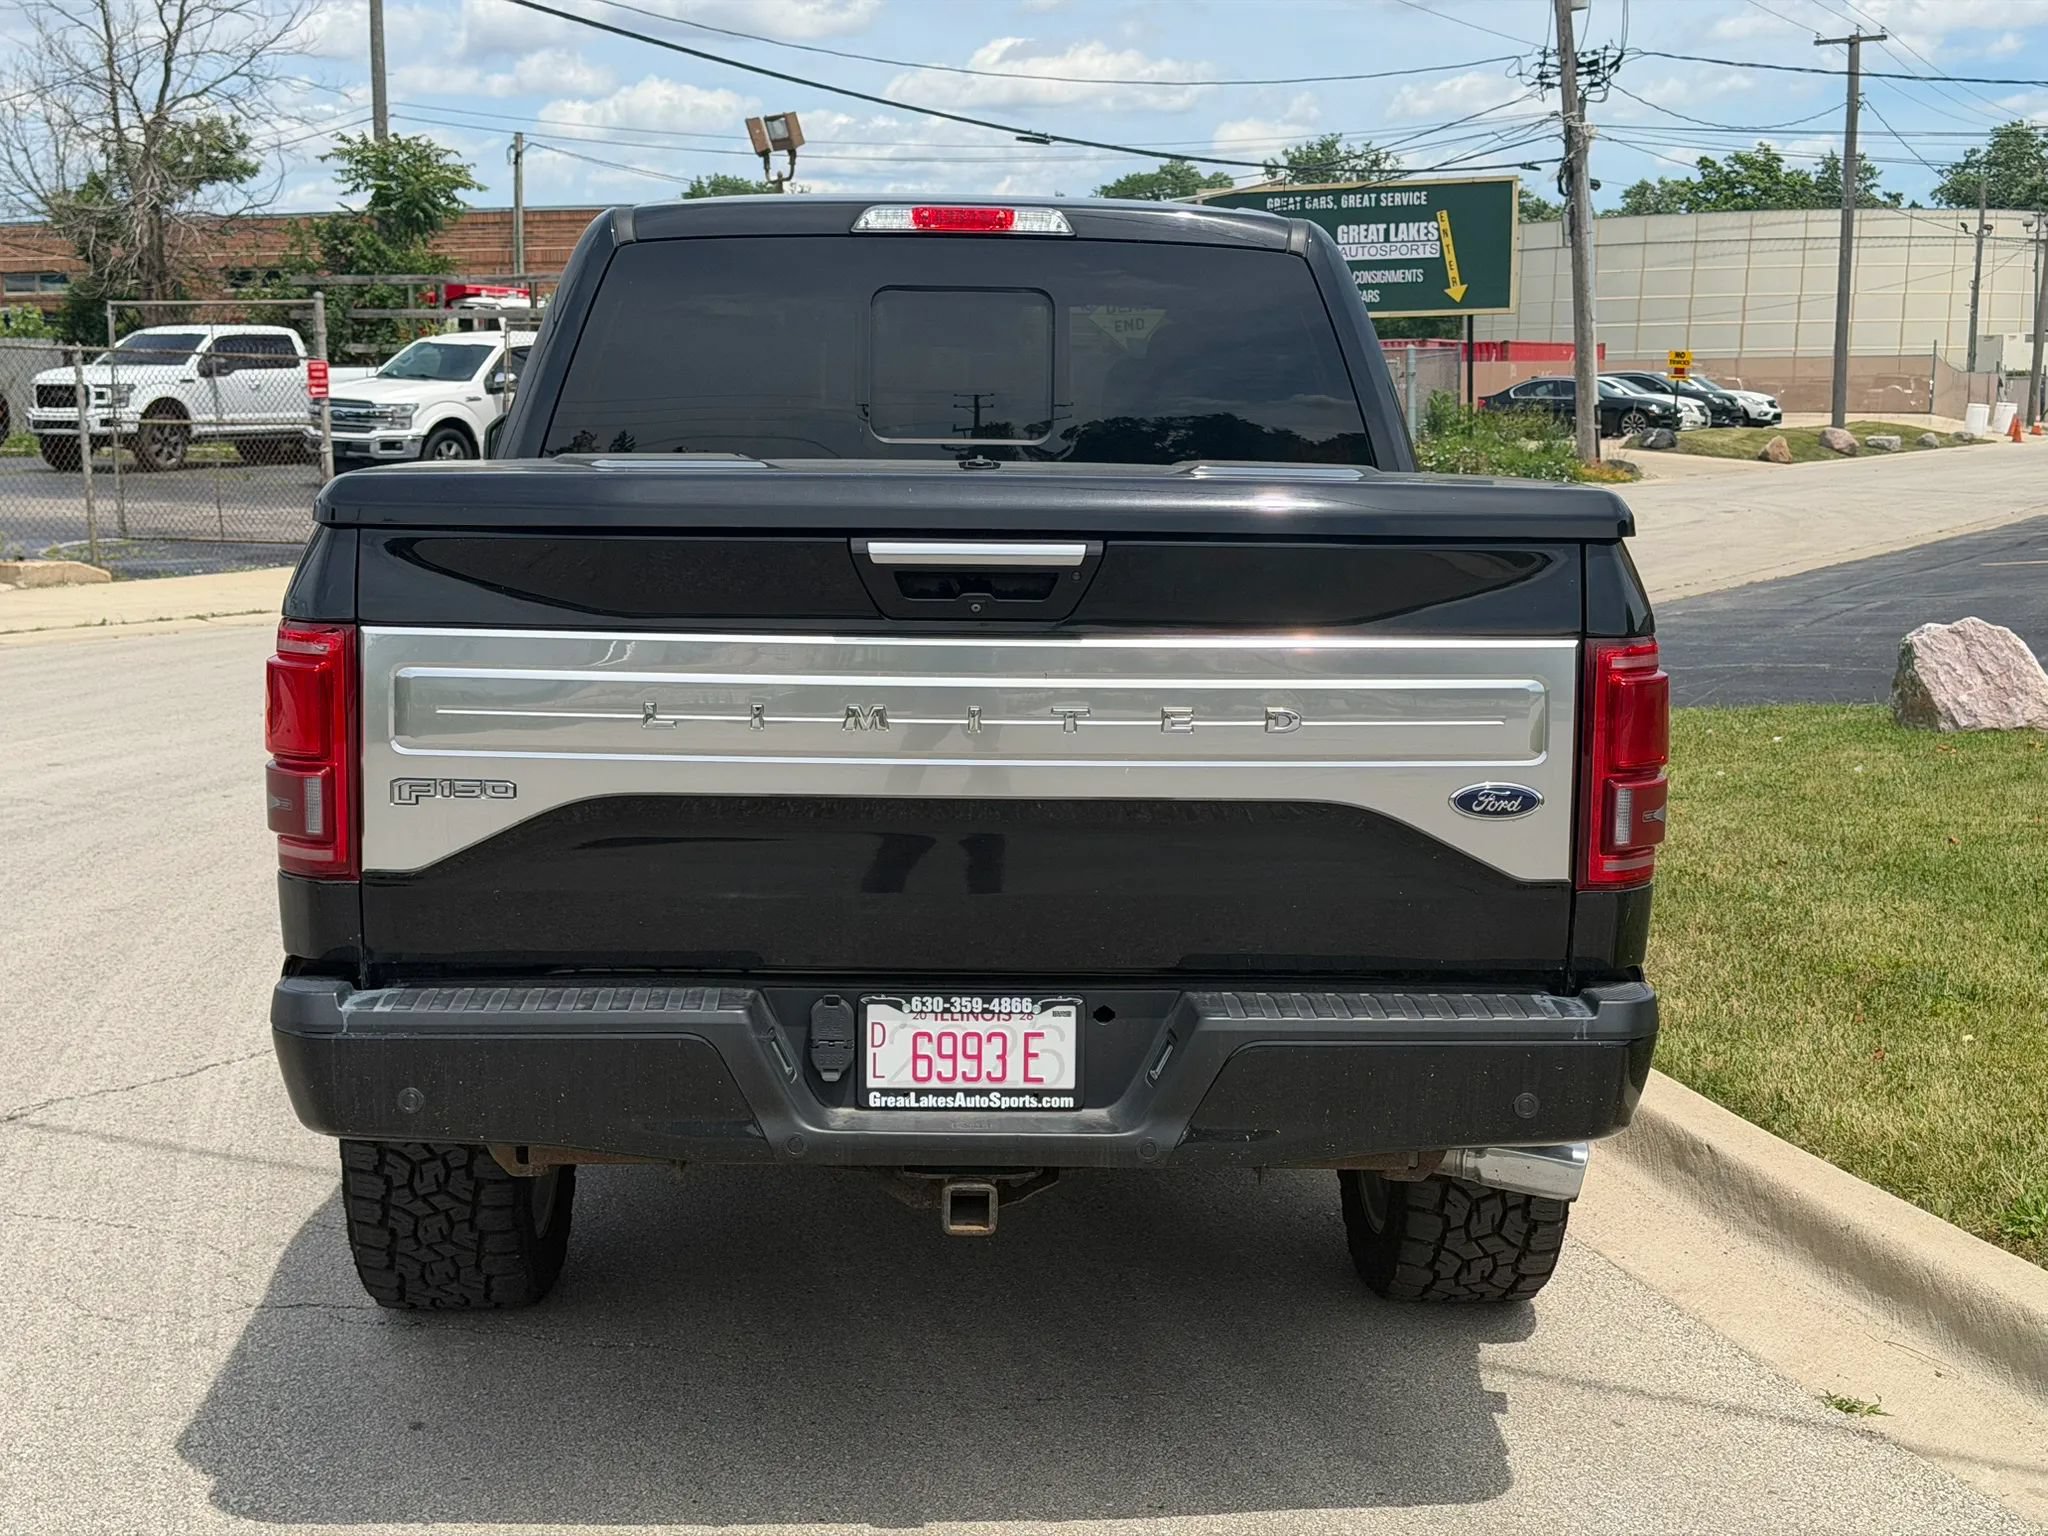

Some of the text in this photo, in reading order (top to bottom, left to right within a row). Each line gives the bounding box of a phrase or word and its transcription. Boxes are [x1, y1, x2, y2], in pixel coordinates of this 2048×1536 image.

[1266, 196, 1302, 212] GREAT
[1341, 193, 1377, 208] GREAT
[1380, 191, 1428, 207] SERVICE
[1337, 221, 1438, 244] GREAT LAKES
[1341, 243, 1439, 258] AUTOSPORTS
[1440, 212, 1458, 287] ENTER
[1353, 268, 1424, 284] CONSIGNMENTS
[1360, 289, 1380, 303] ARS
[1114, 318, 1145, 333] END
[642, 702, 1302, 735] LIMITED
[1471, 789, 1523, 812] Ford
[911, 996, 1033, 1013] 630-359-4866
[912, 1031, 1045, 1083] 6993 E
[868, 1092, 1074, 1110] GreatLakesAutoSports.com
